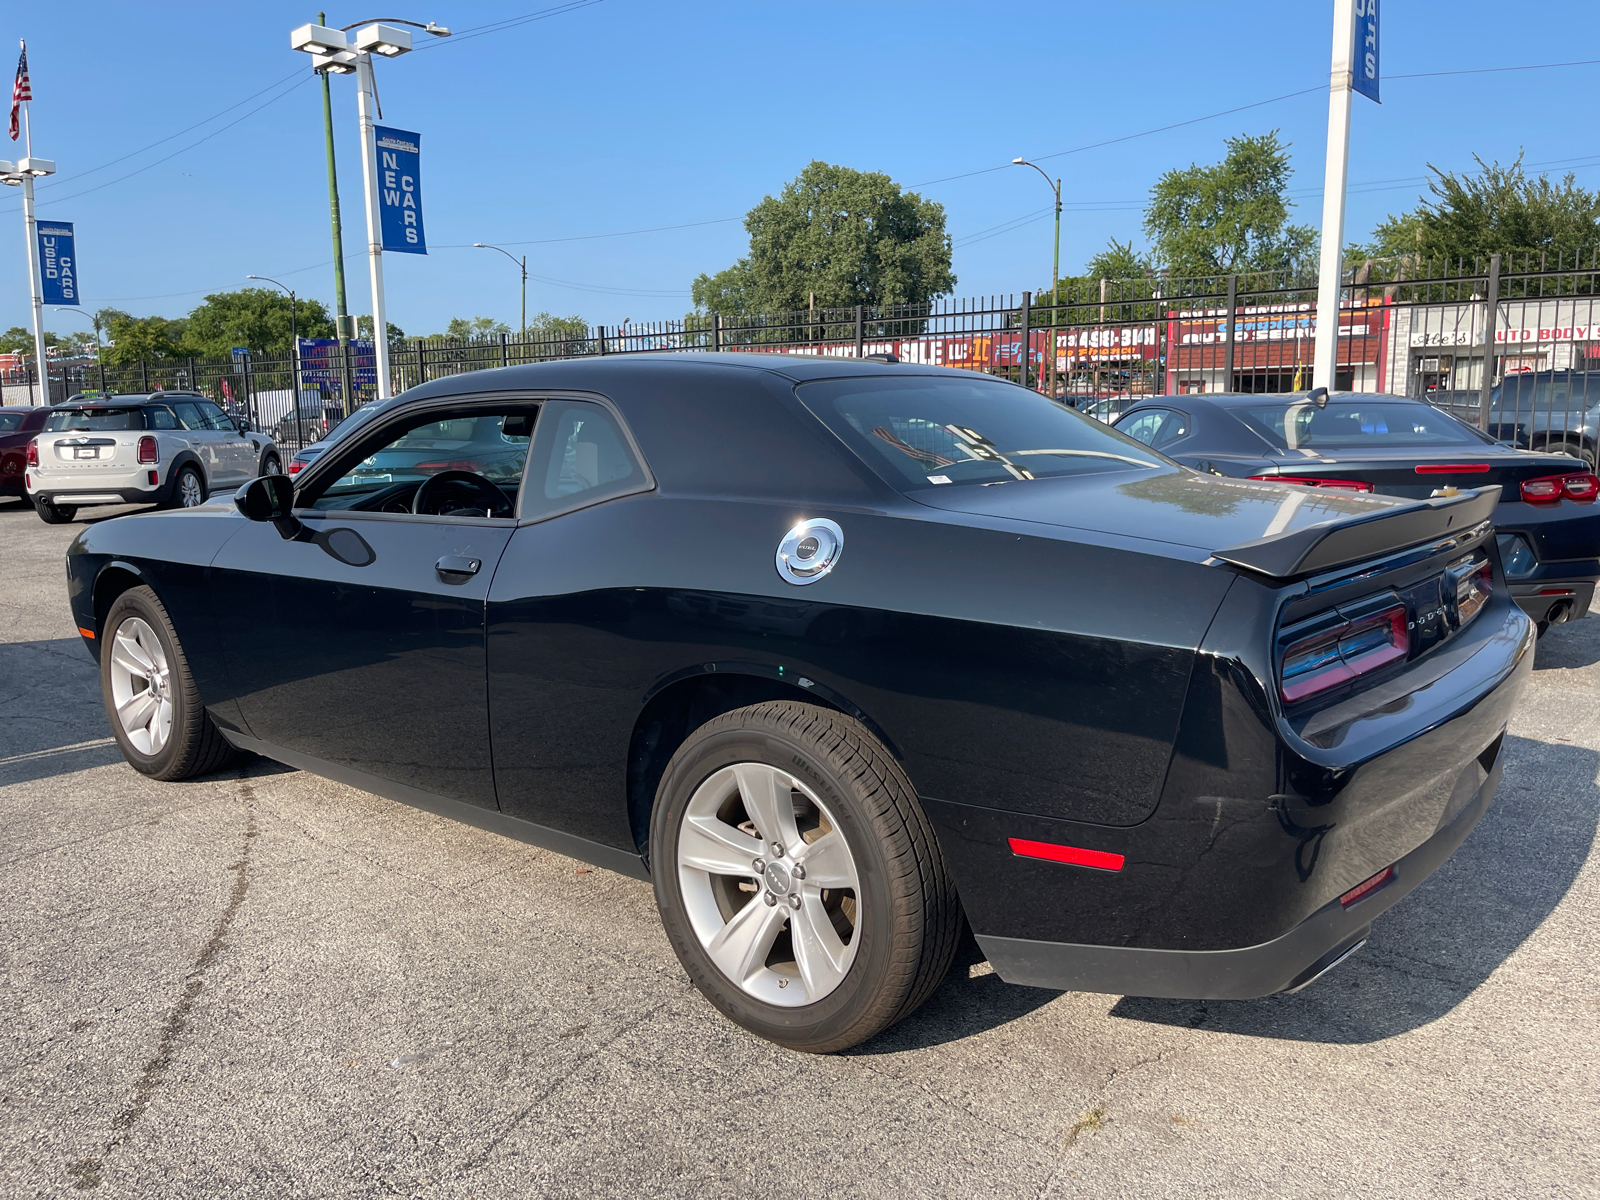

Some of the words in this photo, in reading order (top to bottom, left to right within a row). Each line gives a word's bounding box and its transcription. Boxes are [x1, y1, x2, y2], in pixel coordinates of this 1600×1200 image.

[382, 151, 401, 207] NEW
[401, 175, 418, 243] CARS
[43, 237, 58, 279] USED
[60, 257, 74, 298] CARS
[1179, 308, 1238, 323] GOLDE
[1182, 331, 1249, 344] AUTO
[1252, 324, 1370, 341] SERVCE
[1494, 329, 1531, 342] UTO
[1538, 327, 1587, 340] BODY
[898, 341, 943, 366] SALE
[948, 343, 968, 360] LLC
